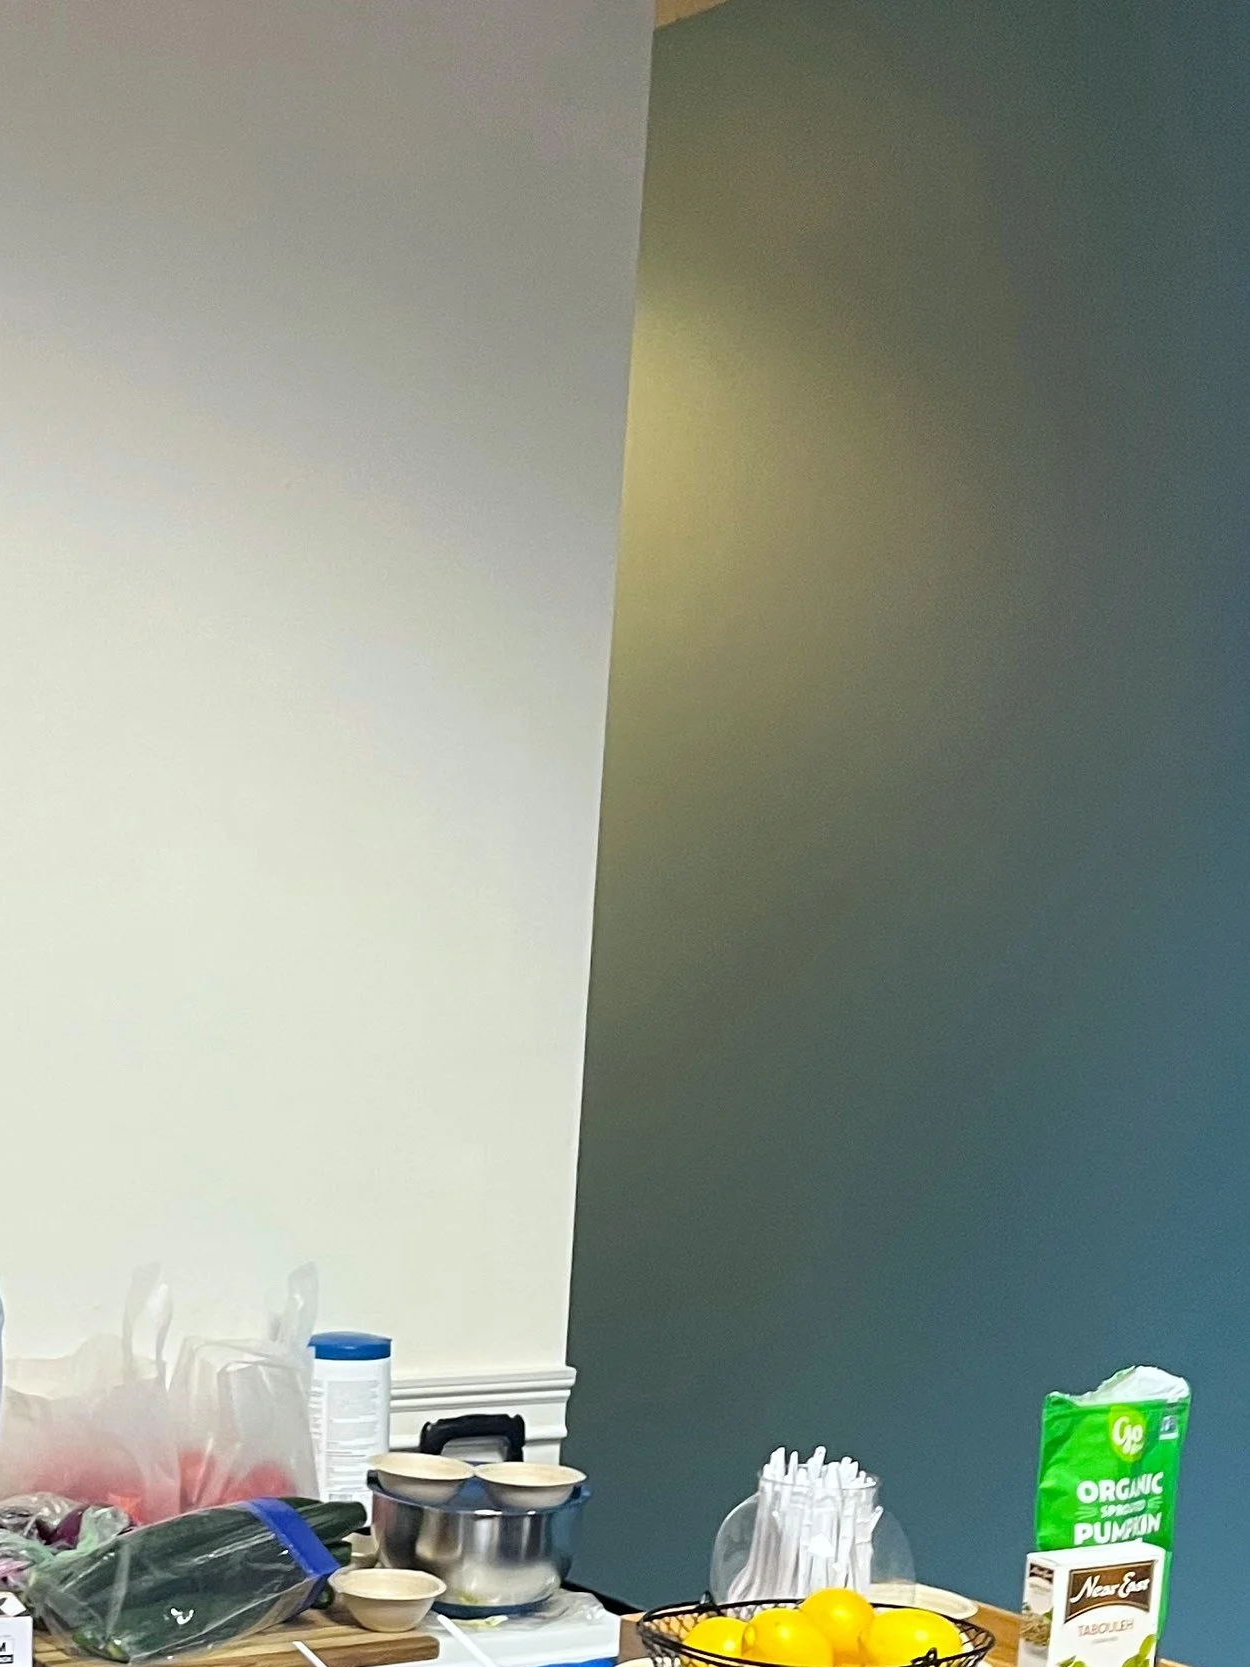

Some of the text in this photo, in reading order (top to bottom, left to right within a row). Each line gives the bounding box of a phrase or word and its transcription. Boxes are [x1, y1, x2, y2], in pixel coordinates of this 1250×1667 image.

[1076, 1471, 1164, 1504] ORGANIC
[1073, 1512, 1162, 1546] PUMPKIN
[1069, 1574, 1121, 1604] Near
[1117, 1571, 1151, 1598] East
